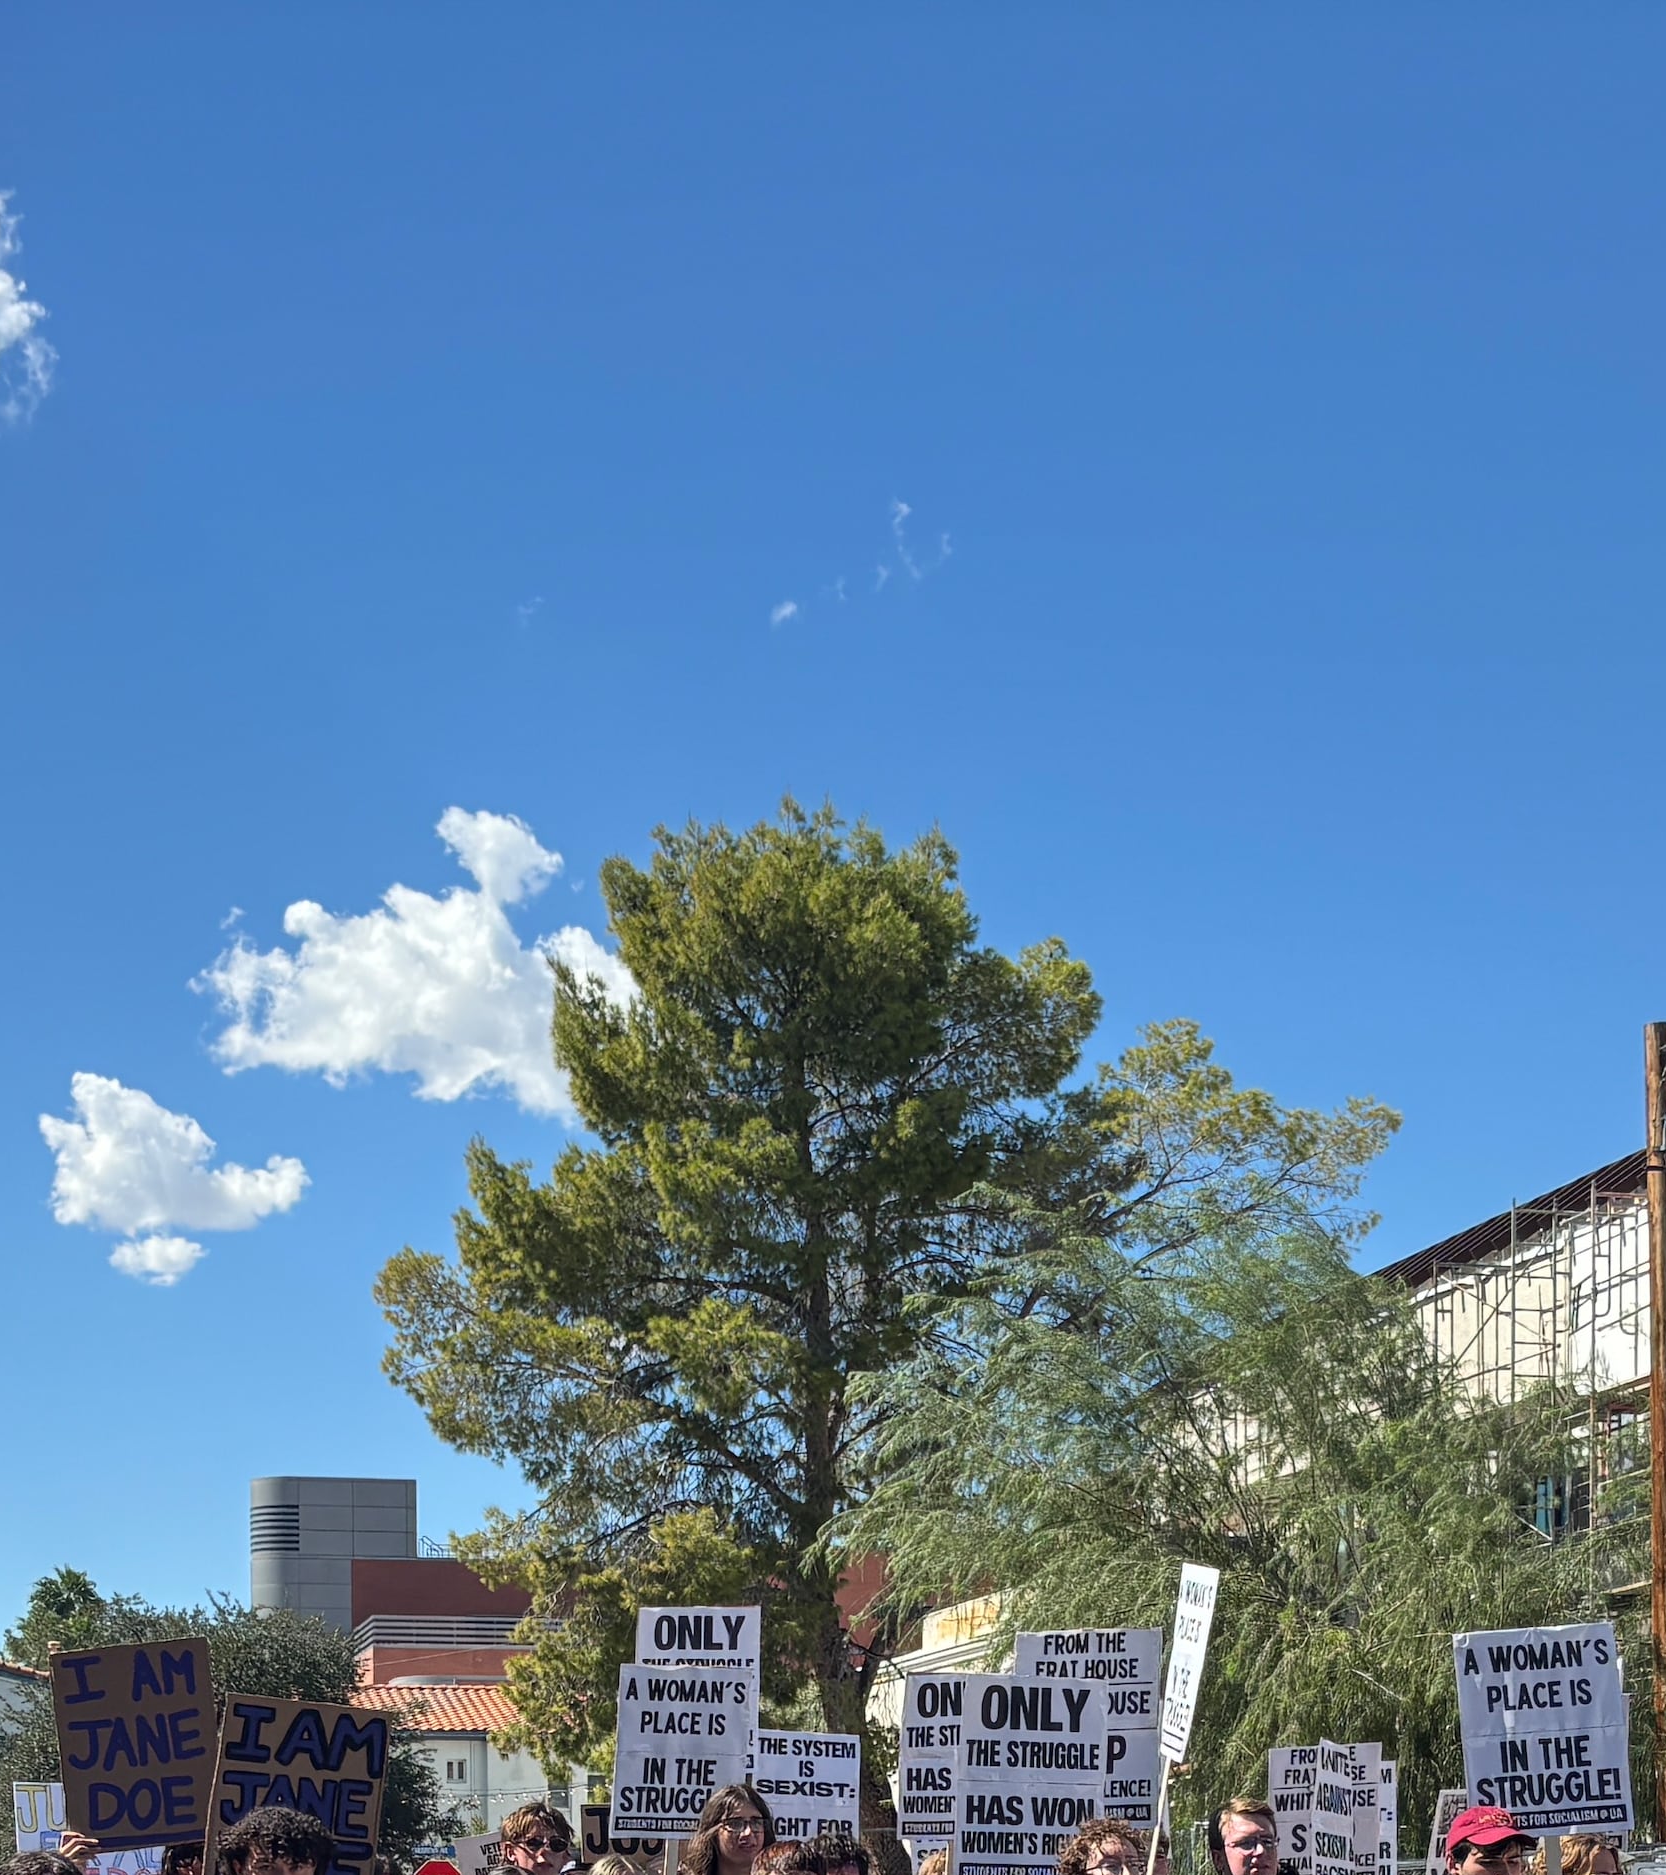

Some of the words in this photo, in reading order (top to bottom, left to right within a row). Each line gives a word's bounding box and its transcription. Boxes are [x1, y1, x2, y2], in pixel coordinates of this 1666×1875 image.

[654, 1615, 745, 1650] ONLY
[1044, 1634, 1089, 1655] FROM
[1097, 1632, 1127, 1653] THE
[1085, 1658, 1139, 1679] HOUSE
[1464, 1648, 1479, 1675] A
[61, 1656, 106, 1704] I
[131, 1649, 196, 1700] AM
[626, 1678, 638, 1700] A
[981, 1686, 1090, 1732] ONLY
[1487, 1680, 1562, 1712] PLACE
[1571, 1678, 1592, 1705] IS
[641, 1711, 702, 1735] PLACE
[708, 1713, 726, 1736] IS
[907, 1727, 934, 1747] THE
[67, 1708, 206, 1772] JANE
[225, 1703, 276, 1763] I
[275, 1708, 387, 1778] AM
[759, 1737, 787, 1755] THE
[792, 1740, 856, 1759] SYSTEM
[1500, 1740, 1528, 1773] IN
[1538, 1735, 1591, 1769] THE
[799, 1760, 814, 1777] IS
[967, 1740, 1001, 1767] THE
[1007, 1742, 1099, 1770] STRUGGLE
[643, 1758, 666, 1785] IN
[675, 1758, 717, 1786] THE
[907, 1768, 951, 1790] HAS
[619, 1786, 715, 1814] STRUGG
[757, 1779, 855, 1798] SEXIST:
[1316, 1783, 1352, 1816] AGAINST
[1476, 1768, 1621, 1808] STRUGGLE!
[88, 1776, 197, 1831] DOE
[966, 1795, 1023, 1825] HAS
[1031, 1797, 1095, 1827] WON
[1529, 1813, 1548, 1825] FOR
[1549, 1810, 1599, 1823] SOCIALISM
[1609, 1808, 1623, 1820] UA
[818, 1819, 853, 1836] FOR
[961, 1831, 1037, 1855] WOMEN'S
[1315, 1831, 1346, 1861] SEXISM
